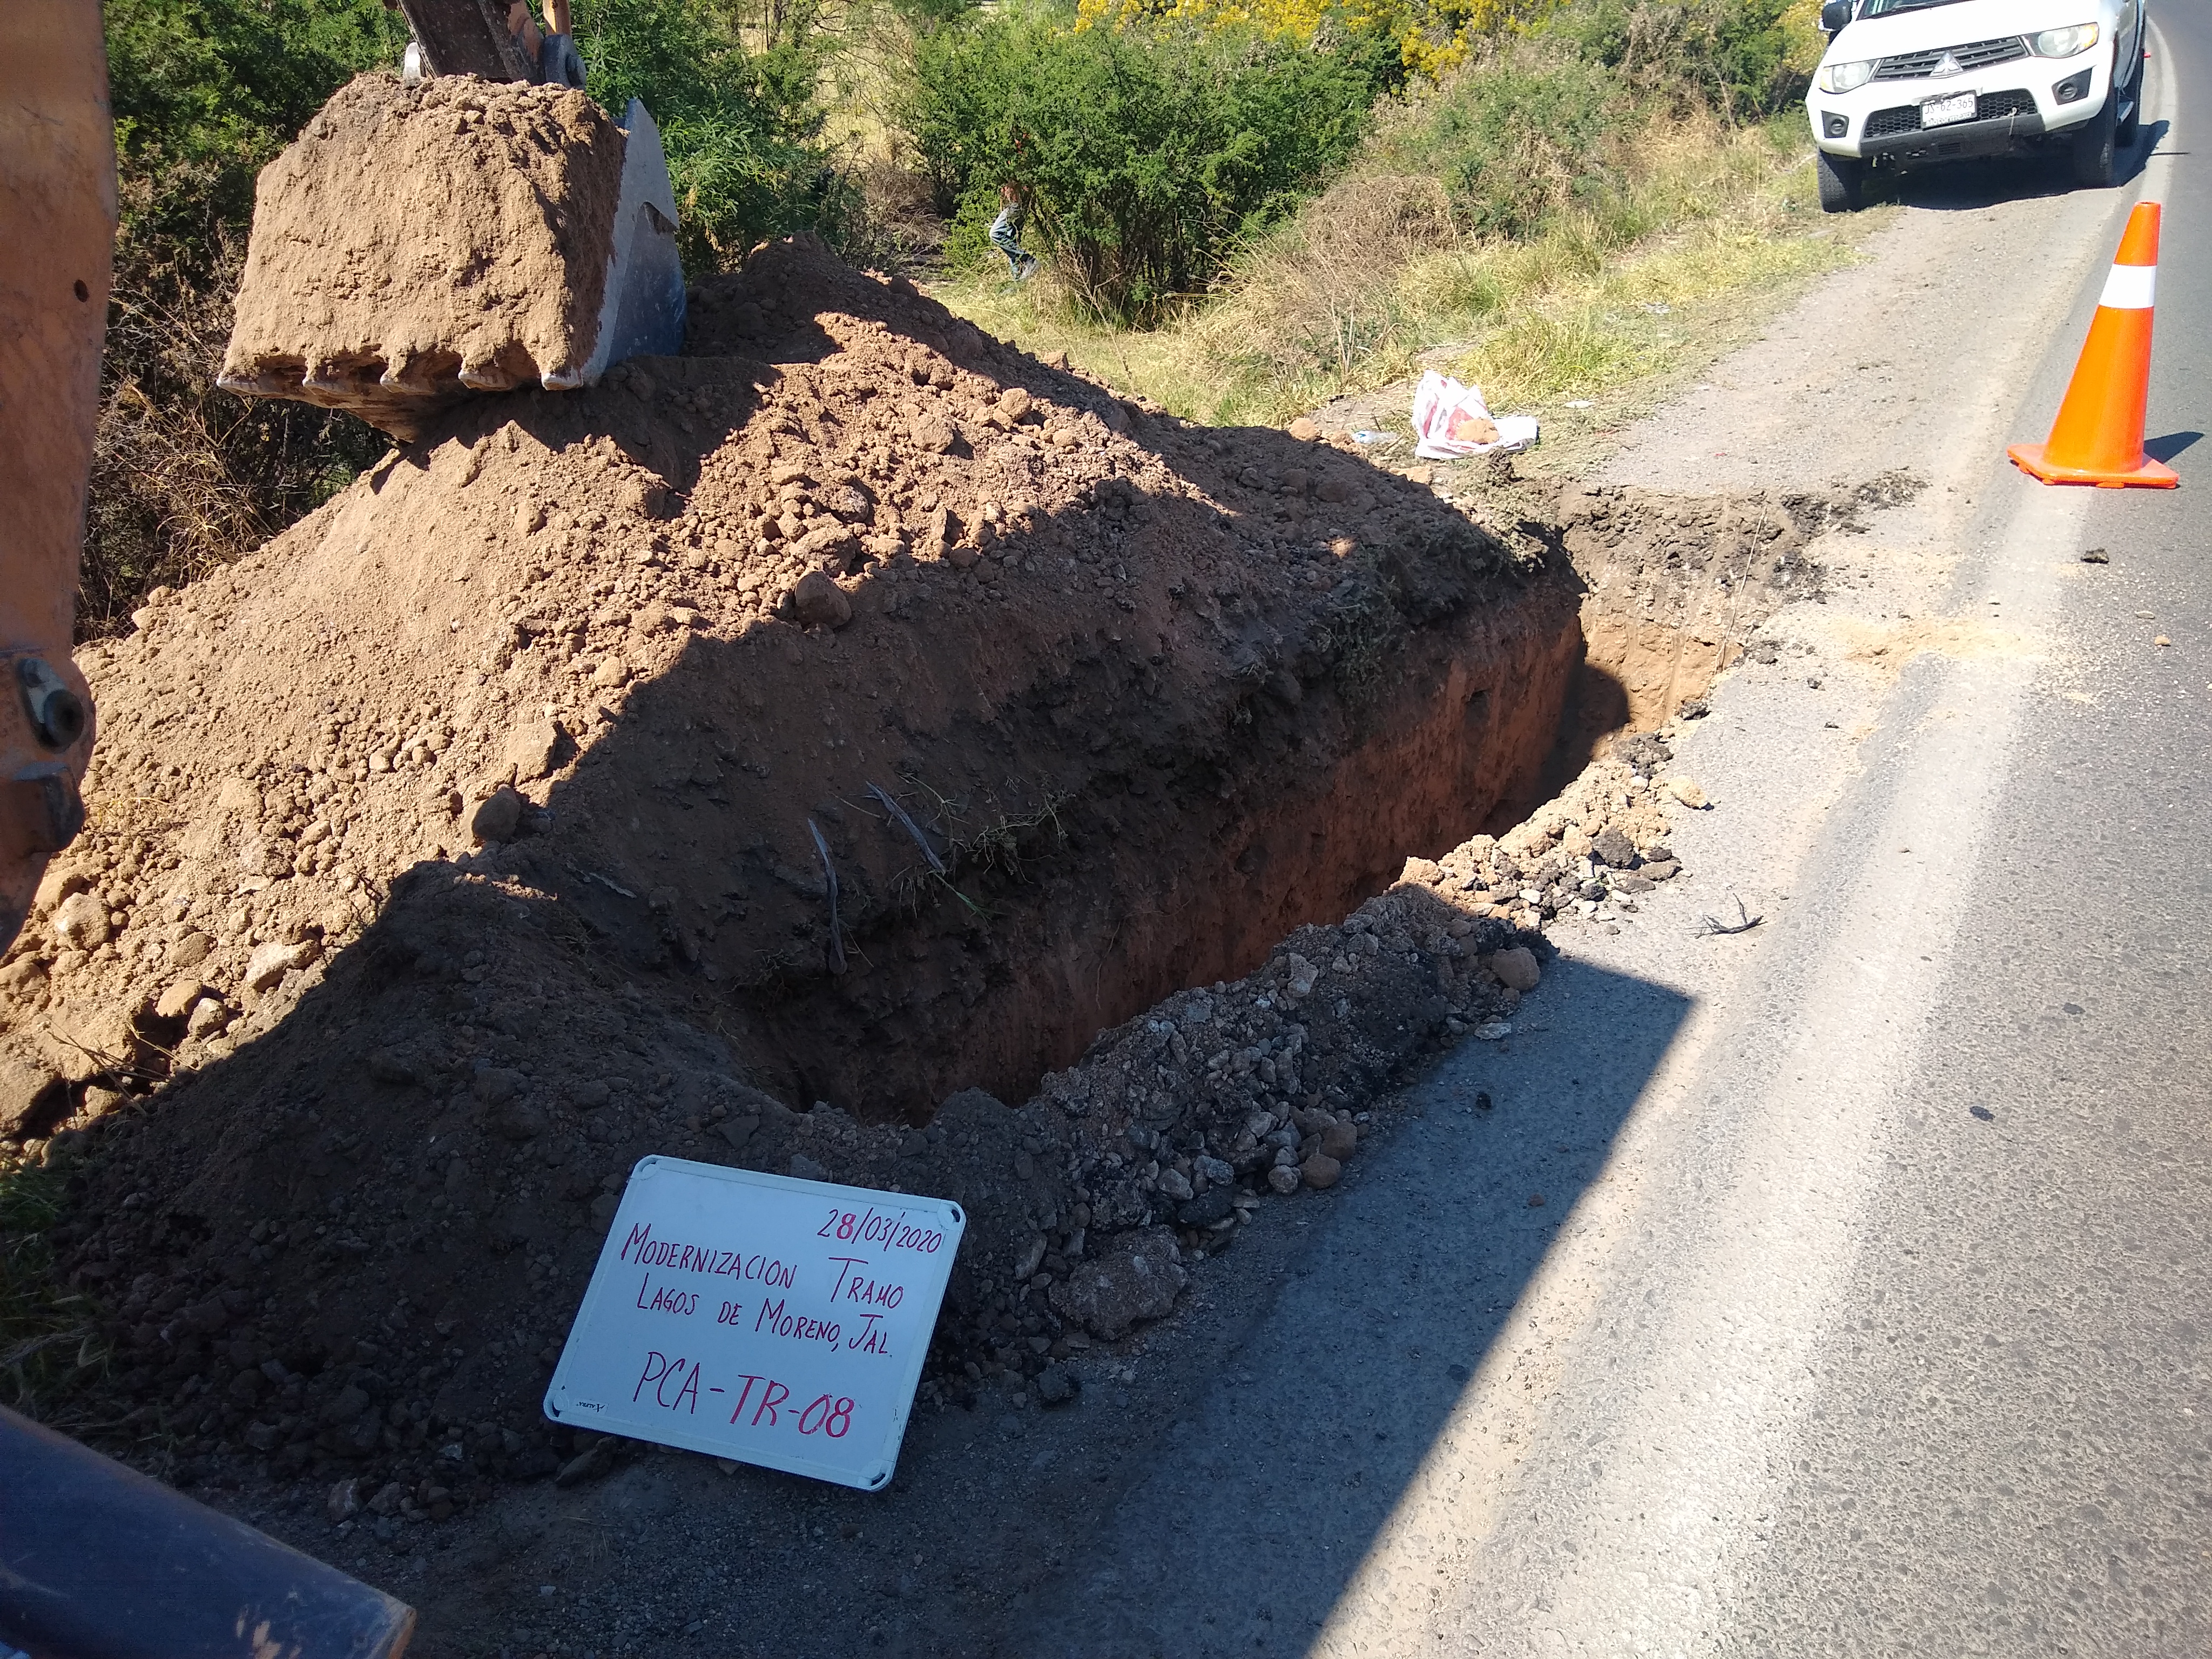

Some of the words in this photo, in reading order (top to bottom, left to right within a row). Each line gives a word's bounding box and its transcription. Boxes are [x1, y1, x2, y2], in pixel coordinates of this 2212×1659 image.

[1925, 98, 1973, 114] JS-62-365
[817, 1208, 943, 1253] 28/03/2020
[621, 1223, 798, 1290] MODERNIZACION
[828, 1257, 903, 1310] TRAMO
[637, 1272, 699, 1316] LAGOS
[718, 1301, 743, 1326] DE
[755, 1298, 841, 1352] MORENO,
[848, 1313, 893, 1358] JAL.
